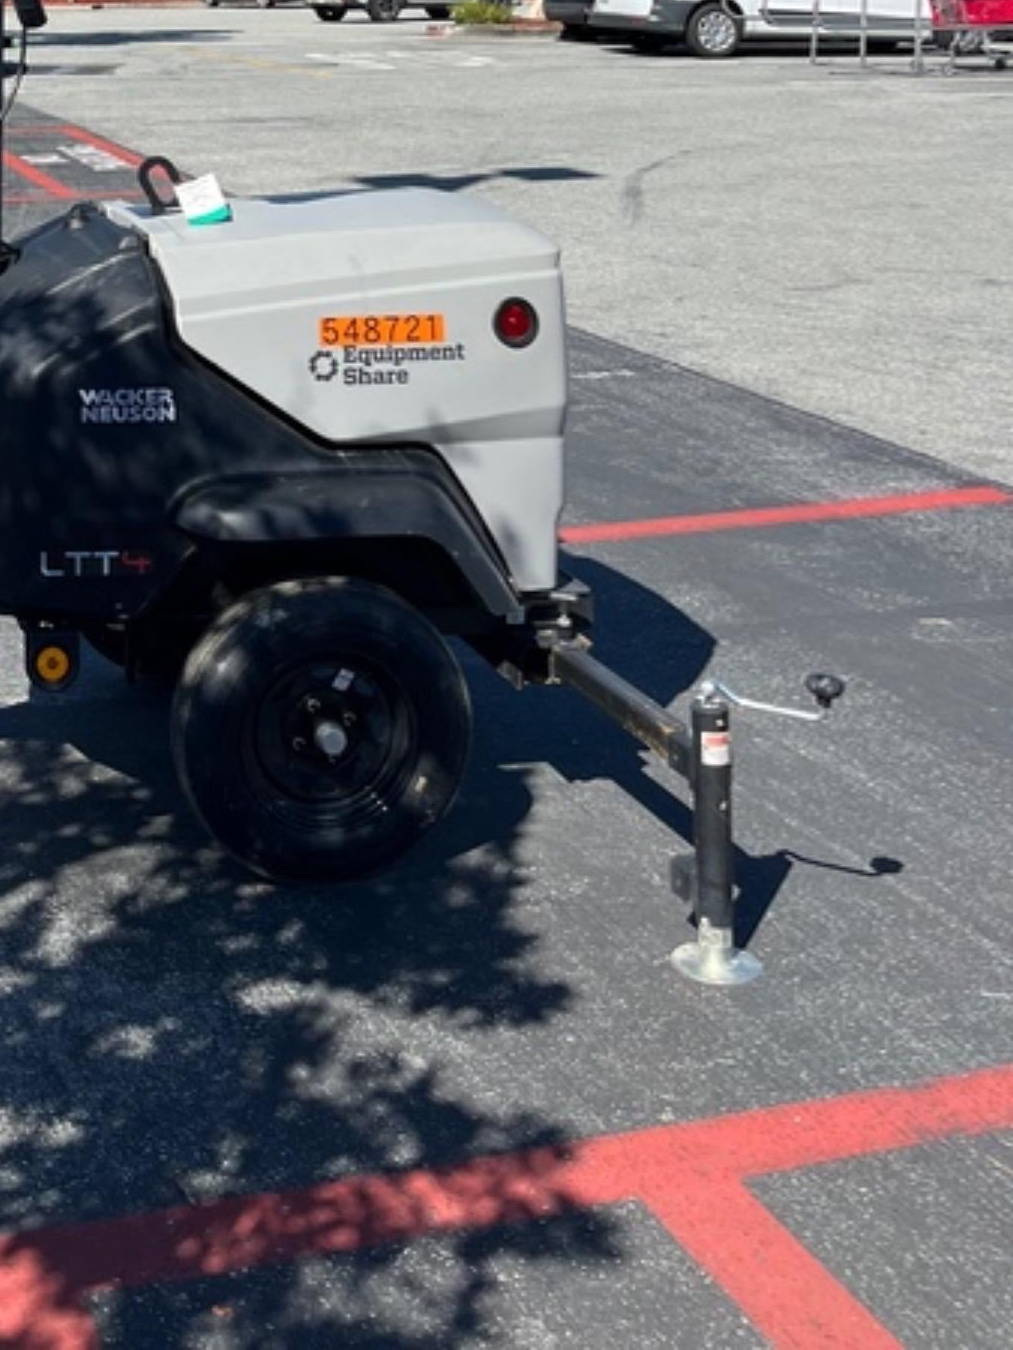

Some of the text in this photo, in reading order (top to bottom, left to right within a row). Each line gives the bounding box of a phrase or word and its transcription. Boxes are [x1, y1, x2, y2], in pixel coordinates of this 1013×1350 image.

[321, 314, 438, 345] 548721
[343, 343, 466, 366] Equipment
[343, 367, 409, 385] Share
[79, 388, 173, 406] WACKER
[81, 406, 176, 423] NEUSON
[40, 550, 151, 577] LTT4
